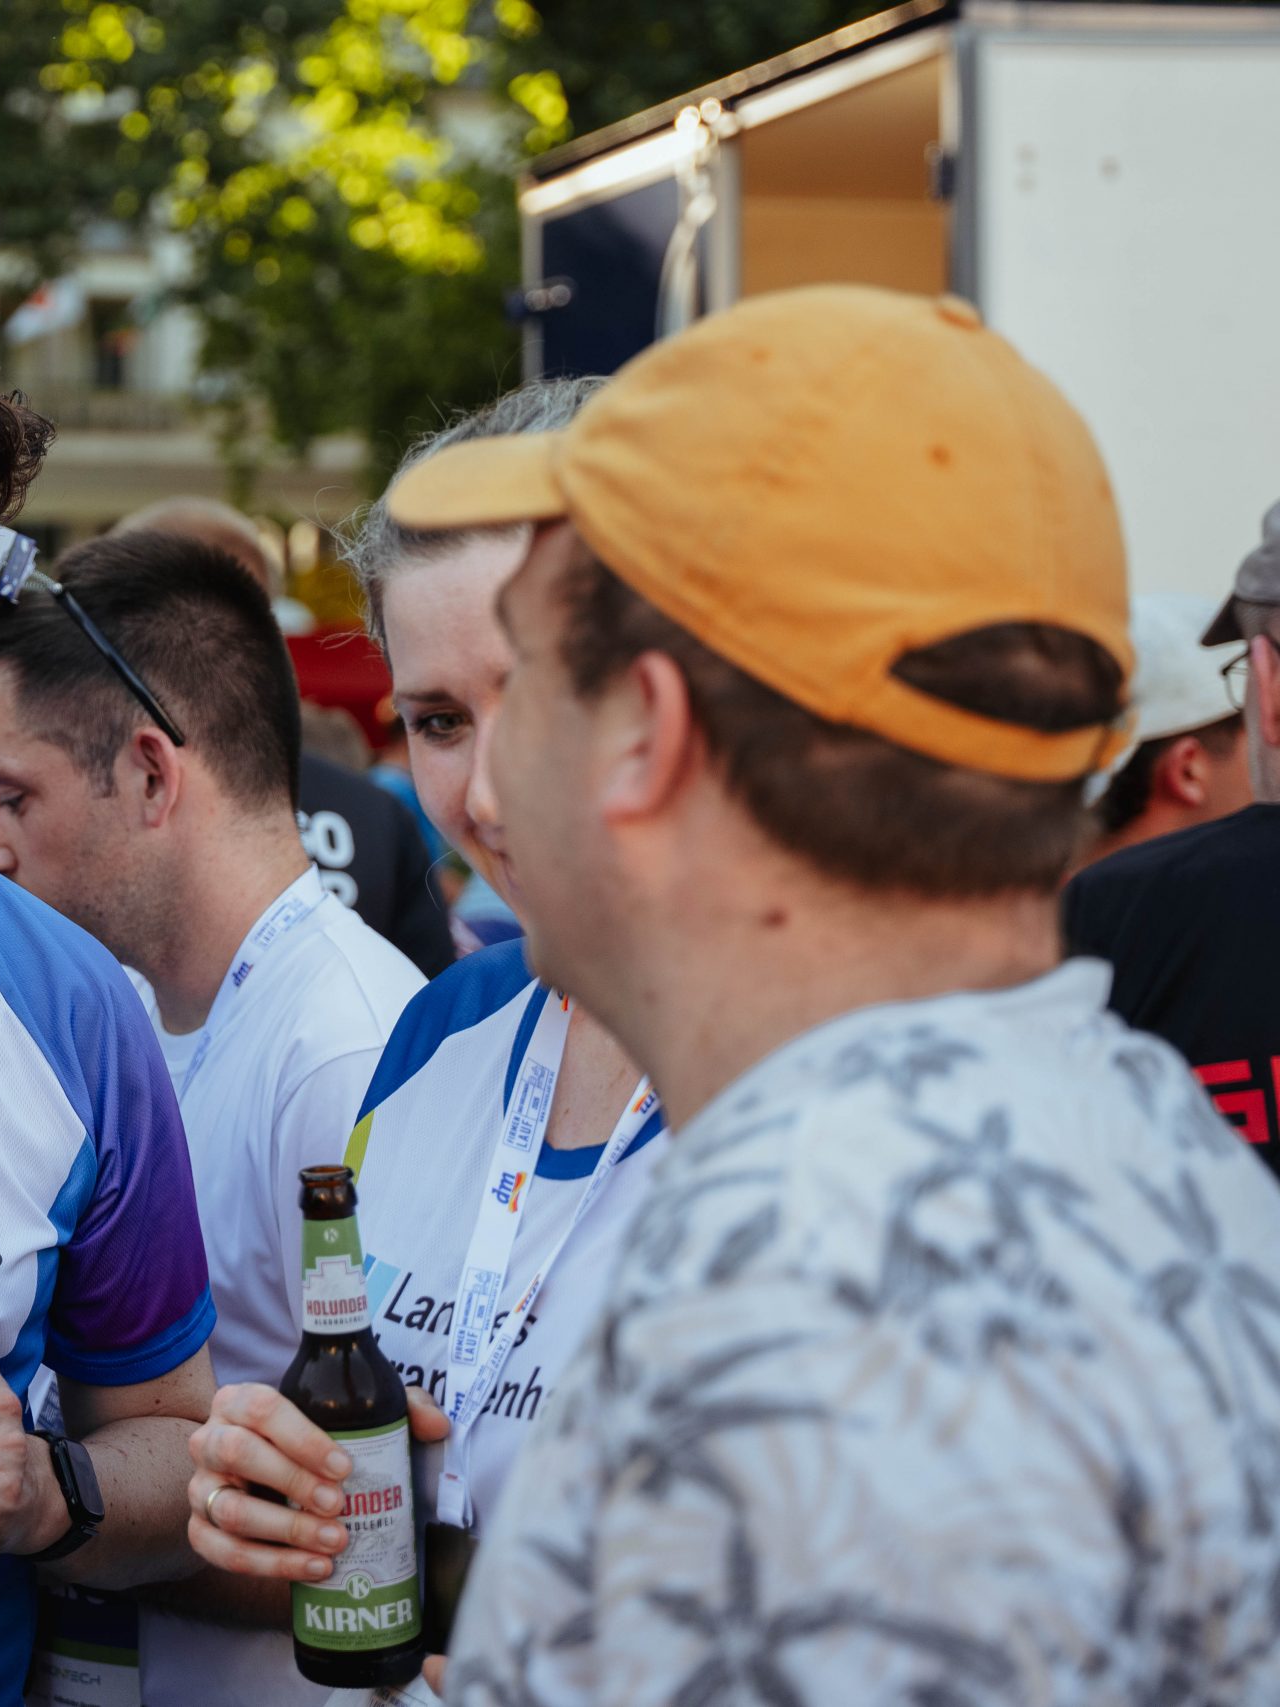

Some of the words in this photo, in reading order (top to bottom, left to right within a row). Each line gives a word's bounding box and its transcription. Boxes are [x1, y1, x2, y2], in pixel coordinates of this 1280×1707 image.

[506, 1115, 520, 1143] FIRMEN
[518, 1119, 532, 1148] LAUF
[491, 1171, 516, 1204] dm
[306, 1295, 368, 1316] HOLUNDER
[383, 1272, 537, 1349] Lanes
[454, 1329, 465, 1359] FIRMEN
[463, 1332, 478, 1361] LAUF
[339, 1484, 403, 1517] UNDER
[350, 1575, 371, 1600] K
[304, 1598, 412, 1632] KIRNER
